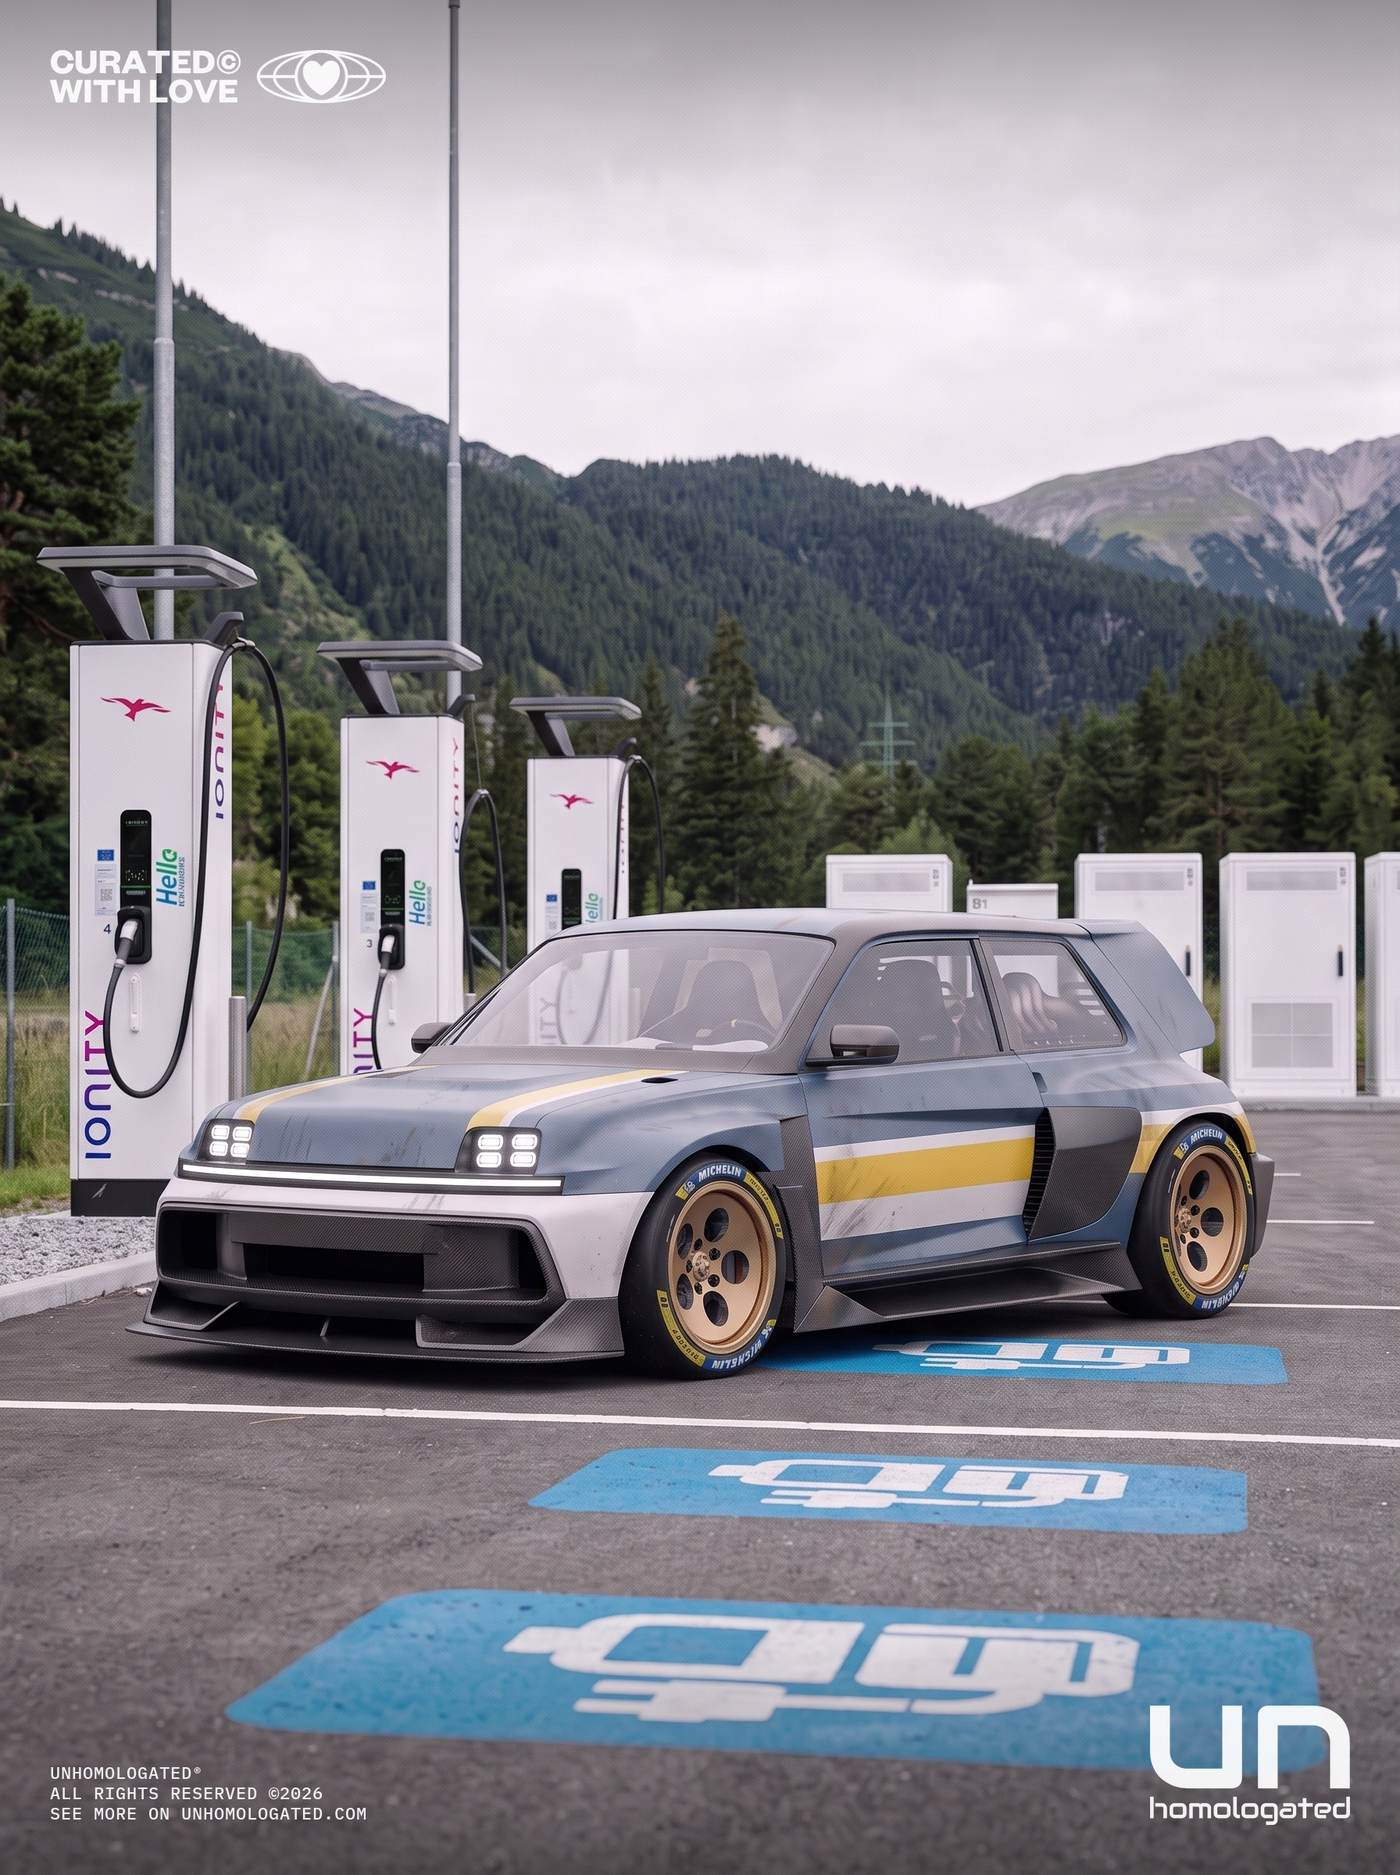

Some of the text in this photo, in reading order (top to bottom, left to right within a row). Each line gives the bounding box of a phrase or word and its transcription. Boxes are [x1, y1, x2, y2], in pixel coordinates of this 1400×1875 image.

[155, 848, 178, 906] Hello
[408, 879, 426, 925] Hello
[585, 892, 599, 924] ello
[103, 923, 112, 934] 4
[366, 939, 373, 948] 3
[1190, 1128, 1223, 1145] MICHELIN
[698, 1164, 742, 1182] MICHELIN
